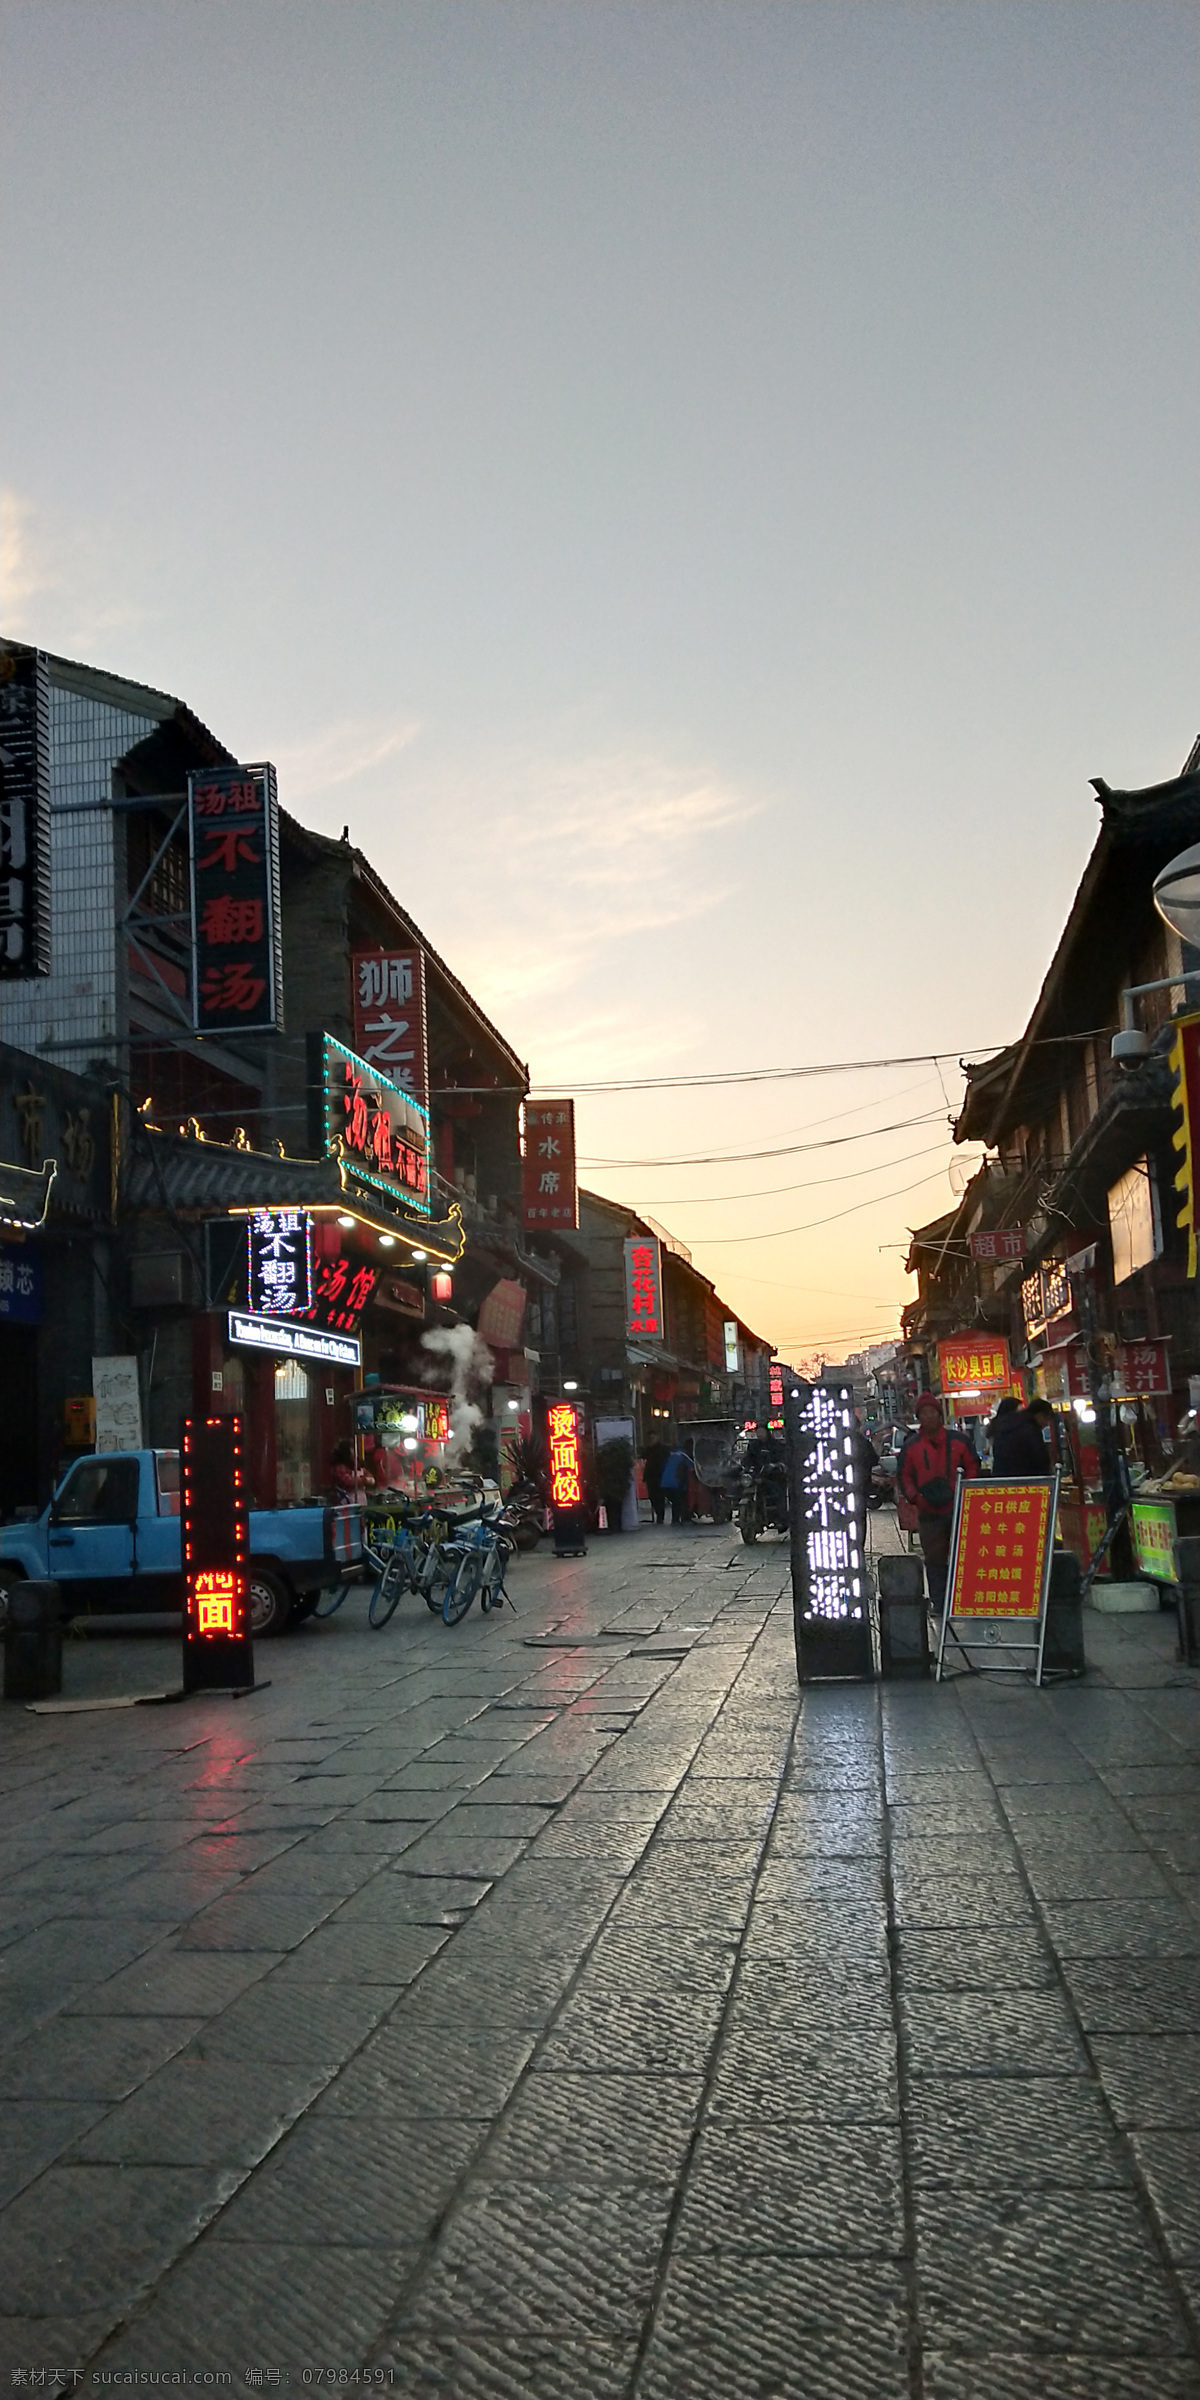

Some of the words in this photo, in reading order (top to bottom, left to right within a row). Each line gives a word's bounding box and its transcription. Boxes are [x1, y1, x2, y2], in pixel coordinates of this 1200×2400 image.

[195, 780, 261, 814] 汤祖
[197, 827, 266, 1011] 不翻汤
[343, 1061, 394, 1173] 汤祖
[538, 1136, 560, 1195] 水席
[253, 1212, 301, 1234] 汤祖
[974, 1233, 1023, 1257] 超市
[257, 1232, 296, 1310] 不翻汤
[630, 1245, 656, 1315] 杏花村
[629, 1318, 658, 1333] 水席
[945, 1353, 1005, 1380] 长沙臭豆腐
[550, 1408, 581, 1502] 烫面饺
[980, 1500, 1031, 1514] 今日供应
